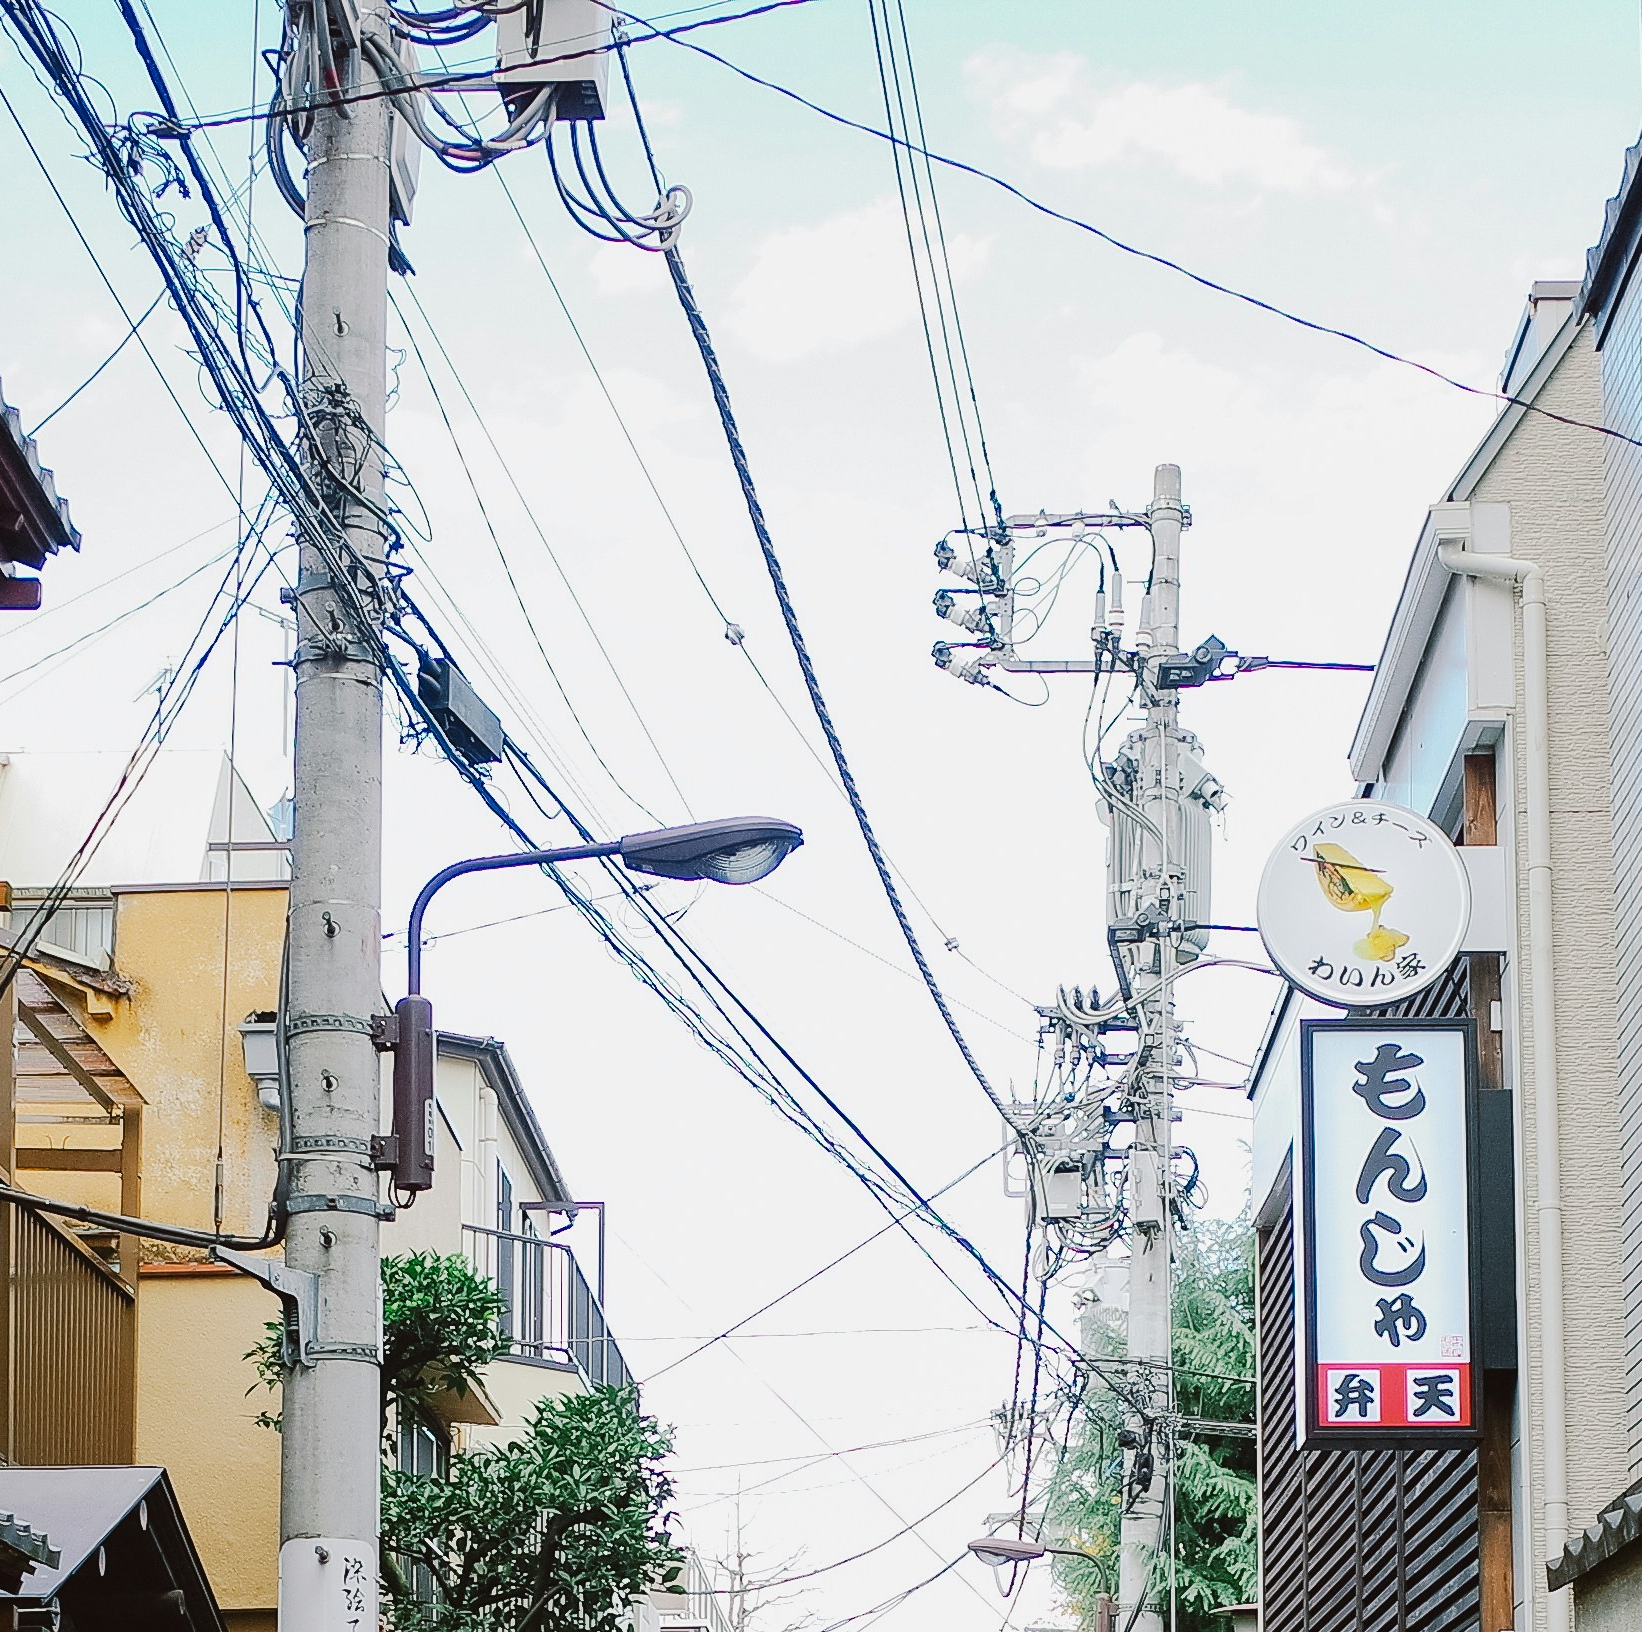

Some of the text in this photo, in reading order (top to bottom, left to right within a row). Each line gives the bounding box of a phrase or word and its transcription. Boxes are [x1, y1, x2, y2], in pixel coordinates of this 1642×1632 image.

[1290, 811, 1433, 852] ワイン&チーズ
[1308, 952, 1426, 988] わいん家
[1352, 1043, 1428, 1348] もんじゃ
[1334, 1373, 1455, 1419] 弁天
